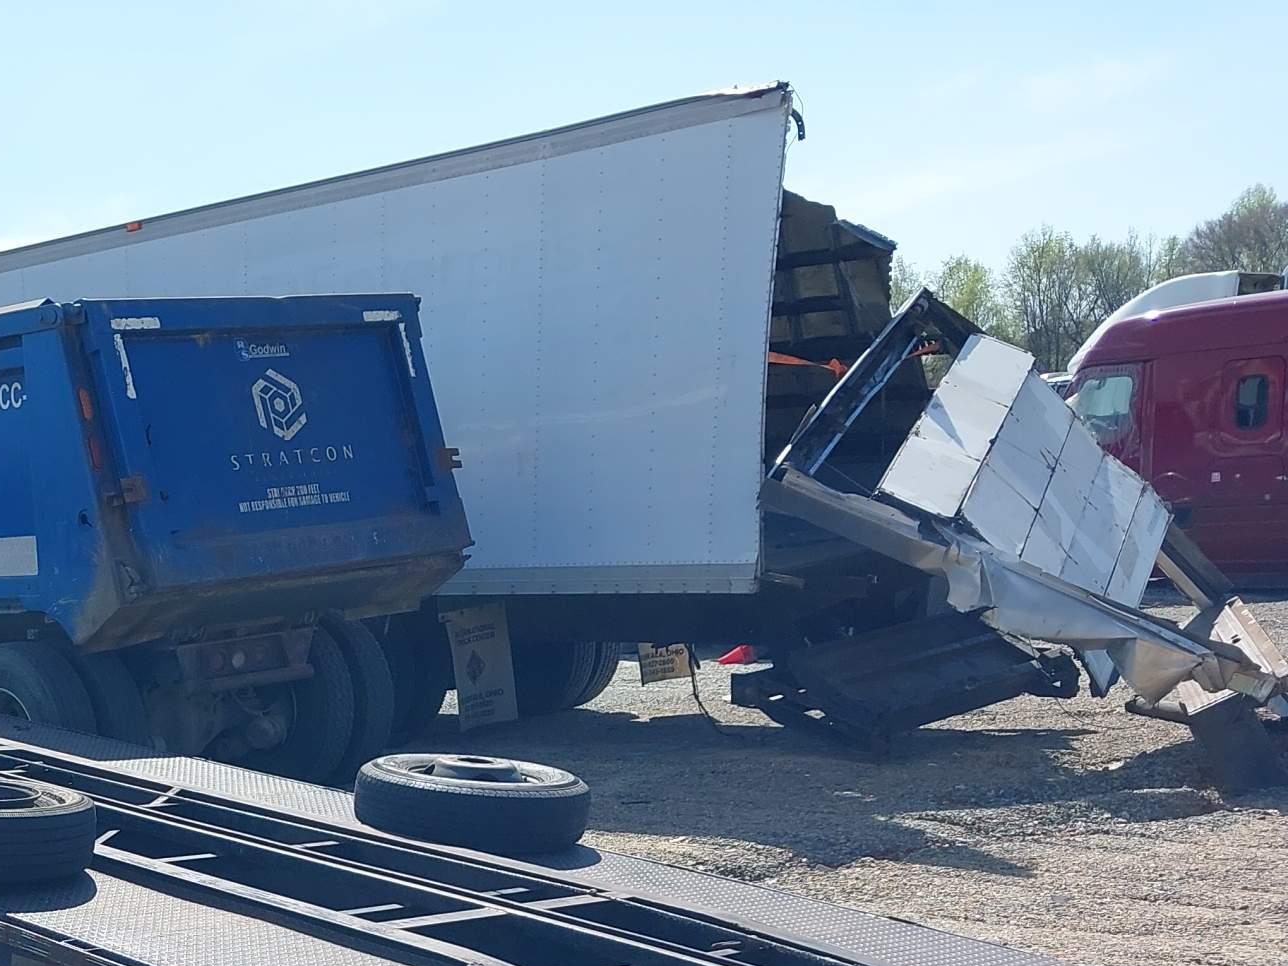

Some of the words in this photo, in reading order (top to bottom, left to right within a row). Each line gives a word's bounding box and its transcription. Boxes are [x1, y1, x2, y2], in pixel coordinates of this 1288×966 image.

[250, 344, 286, 354] Godwin
[231, 444, 354, 471] STRATCON
[239, 502, 251, 513] NOT
[251, 498, 288, 511] RESPONSIBLE
[329, 491, 351, 503] VEHICLE
